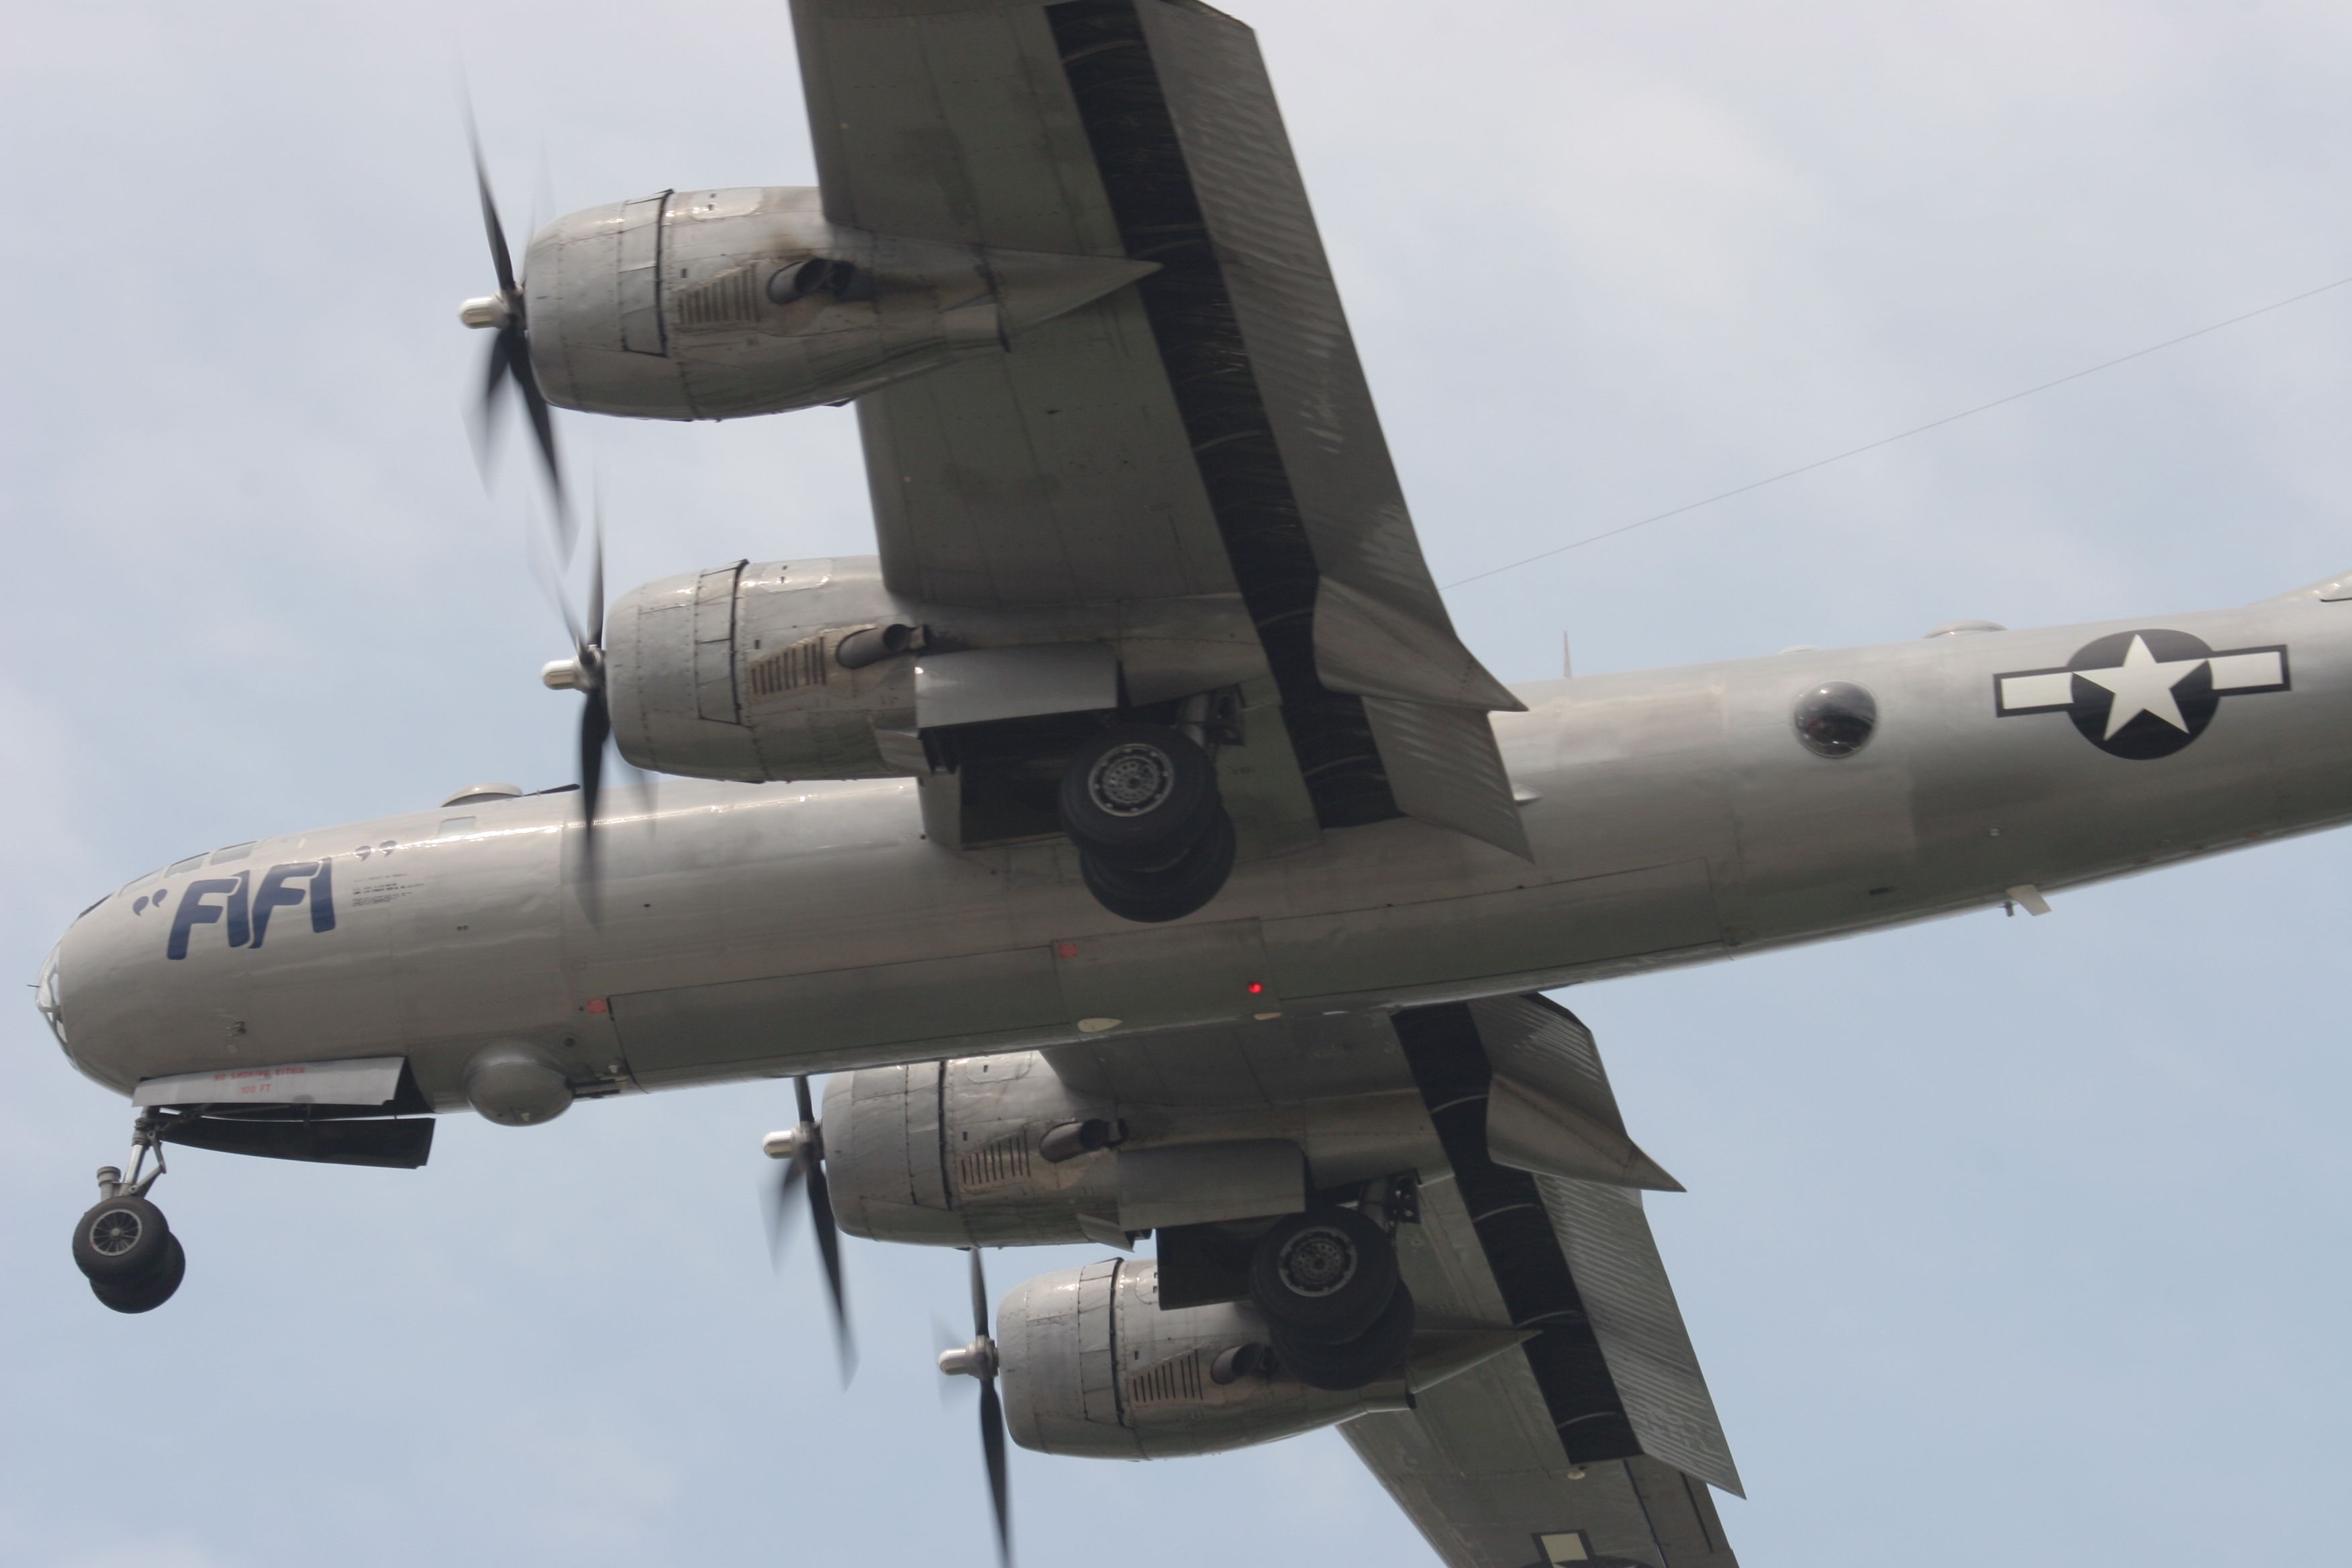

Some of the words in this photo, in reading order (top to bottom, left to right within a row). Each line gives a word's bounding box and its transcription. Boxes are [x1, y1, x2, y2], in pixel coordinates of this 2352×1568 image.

[214, 1073, 226, 1081] NO
[230, 1070, 269, 1080] SMOKING
[260, 1084, 272, 1092] FT
